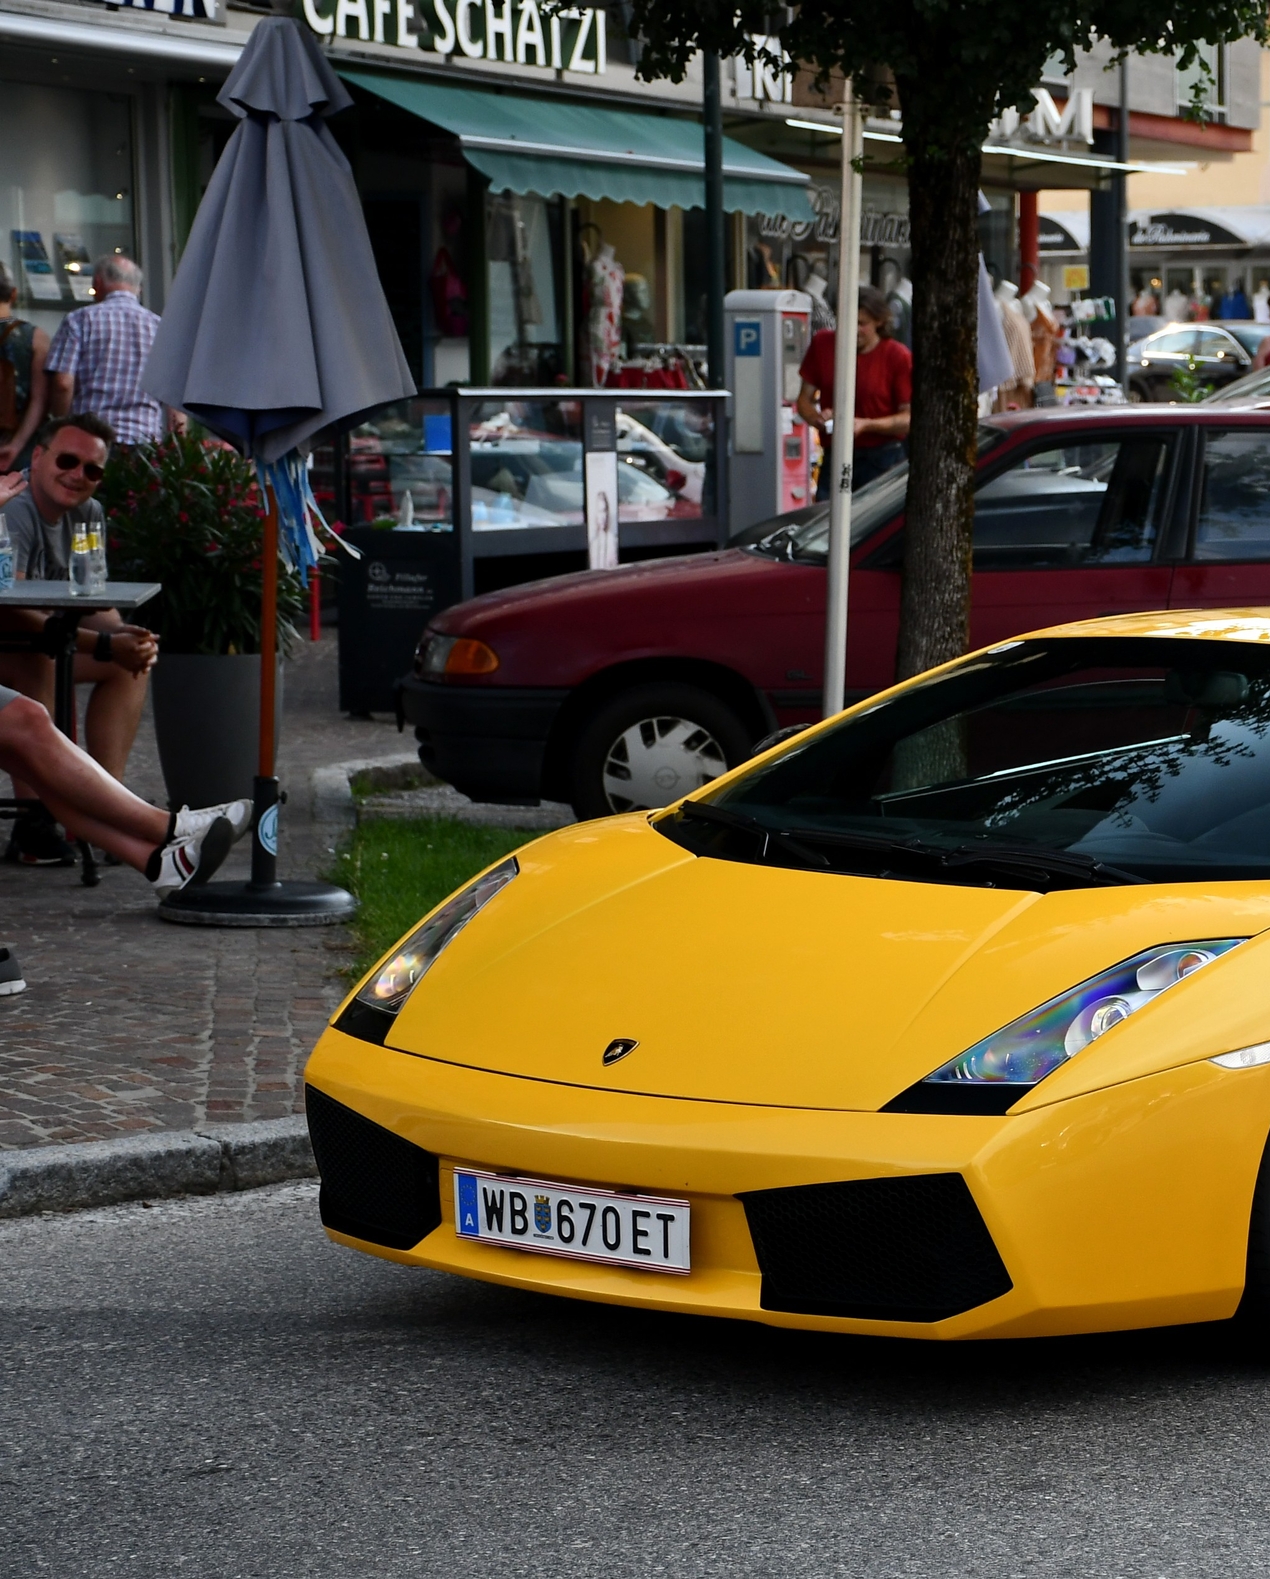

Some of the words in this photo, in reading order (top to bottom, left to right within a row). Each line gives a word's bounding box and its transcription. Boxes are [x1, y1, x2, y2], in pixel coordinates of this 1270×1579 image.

[740, 328, 757, 350] P
[465, 1212, 475, 1227] A
[482, 1186, 528, 1235] WB
[556, 1198, 621, 1250] 670
[631, 1209, 675, 1259] ET
